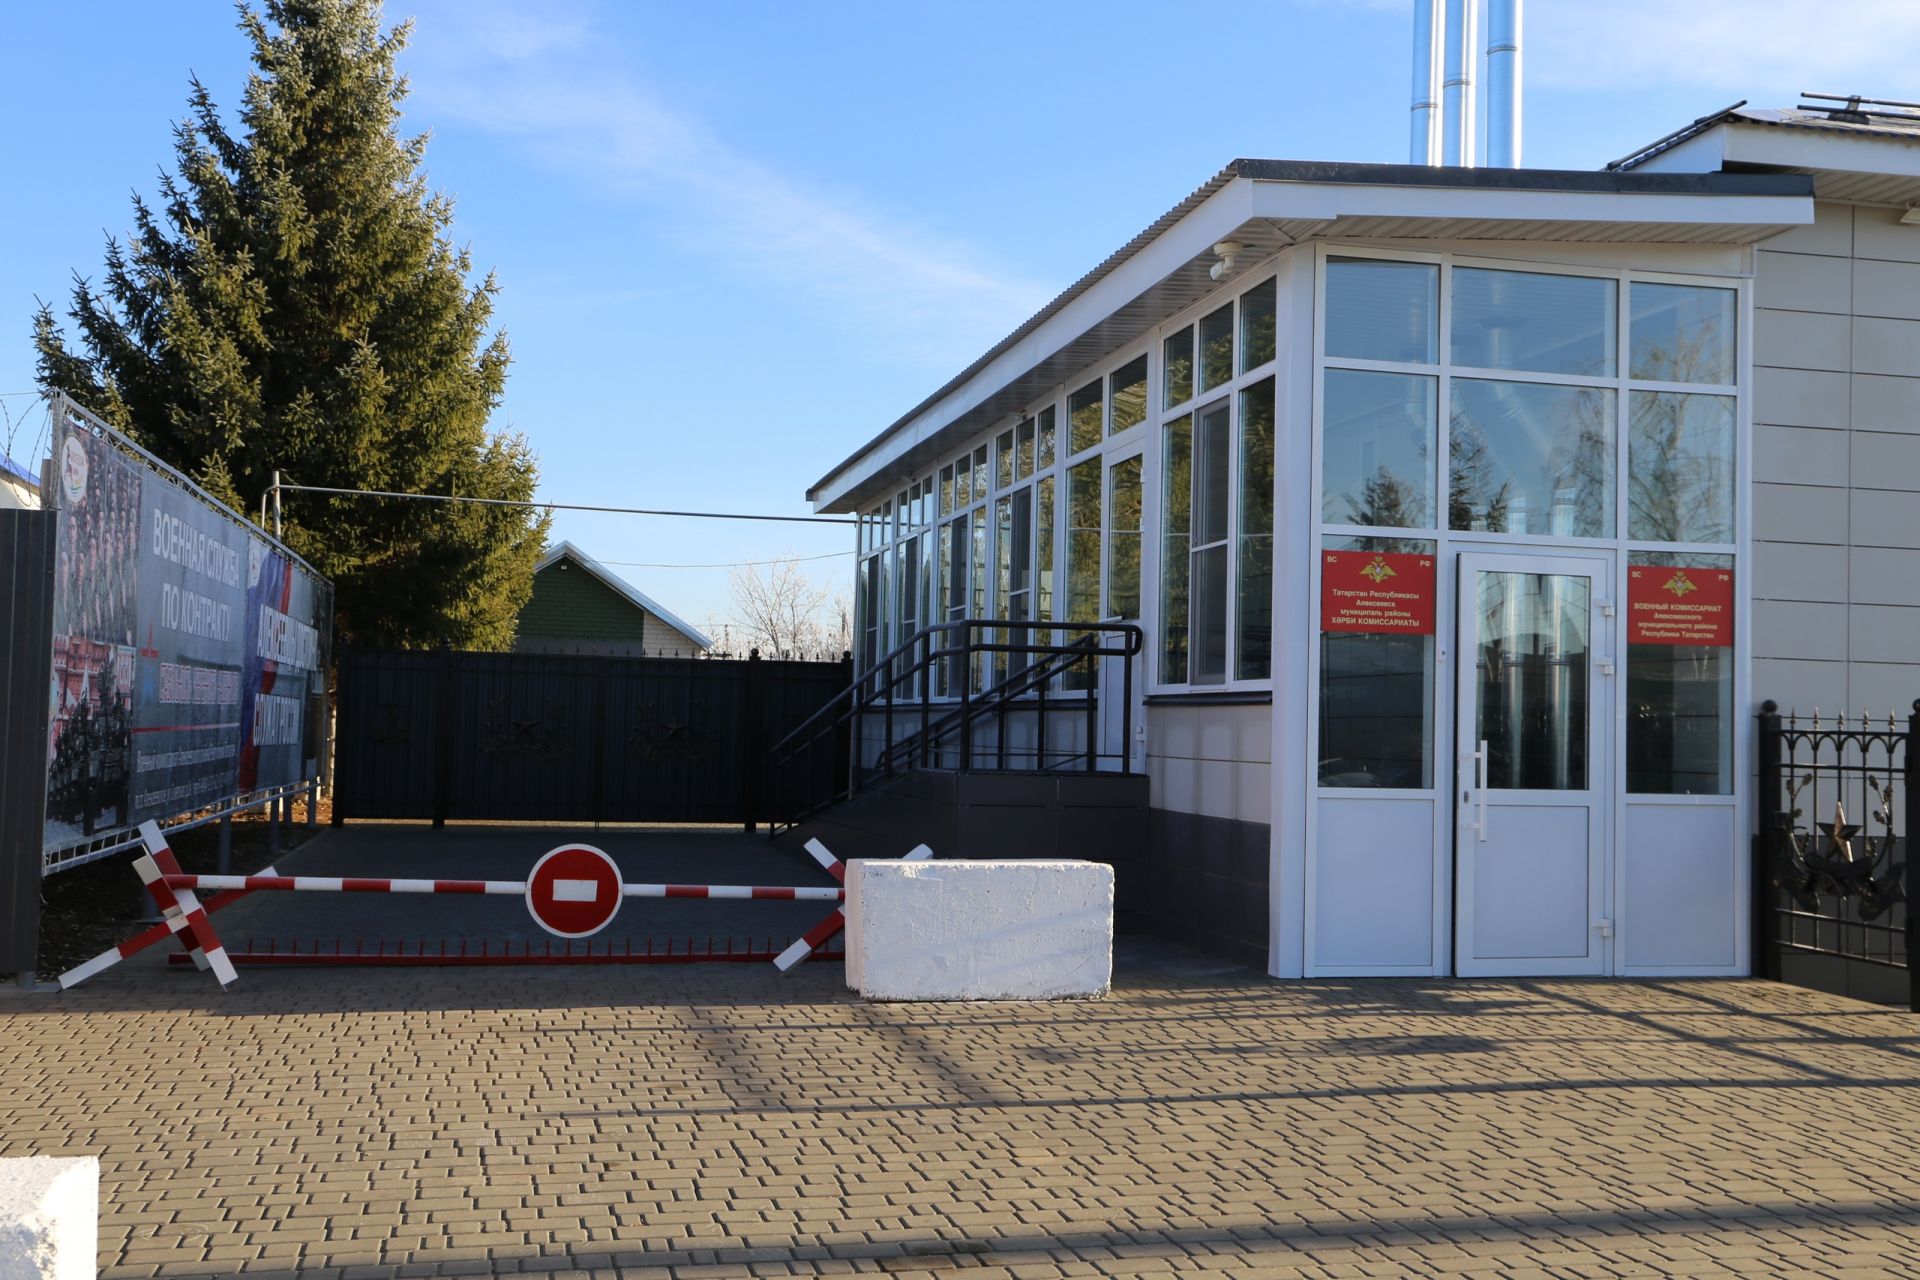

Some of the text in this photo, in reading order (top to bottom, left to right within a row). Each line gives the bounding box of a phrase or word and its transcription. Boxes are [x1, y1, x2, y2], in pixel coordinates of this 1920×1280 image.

[153, 508, 240, 589] ВОЕННАЯ СЛУЖБА
[1327, 555, 1337, 563] ВС
[1333, 589, 1420, 600] Татарстан Республикасы
[161, 582, 232, 642] ПО КОНТРАКТУ
[1634, 602, 1722, 612] ВОЕННЫЙ КОМИССАРИАТ
[1340, 608, 1411, 618] муниципаль районы
[1358, 617, 1420, 627] КОМИССАРИАТЫ
[1638, 622, 1718, 630] муниципального района
[1641, 630, 1714, 639] Республики Татарстан
